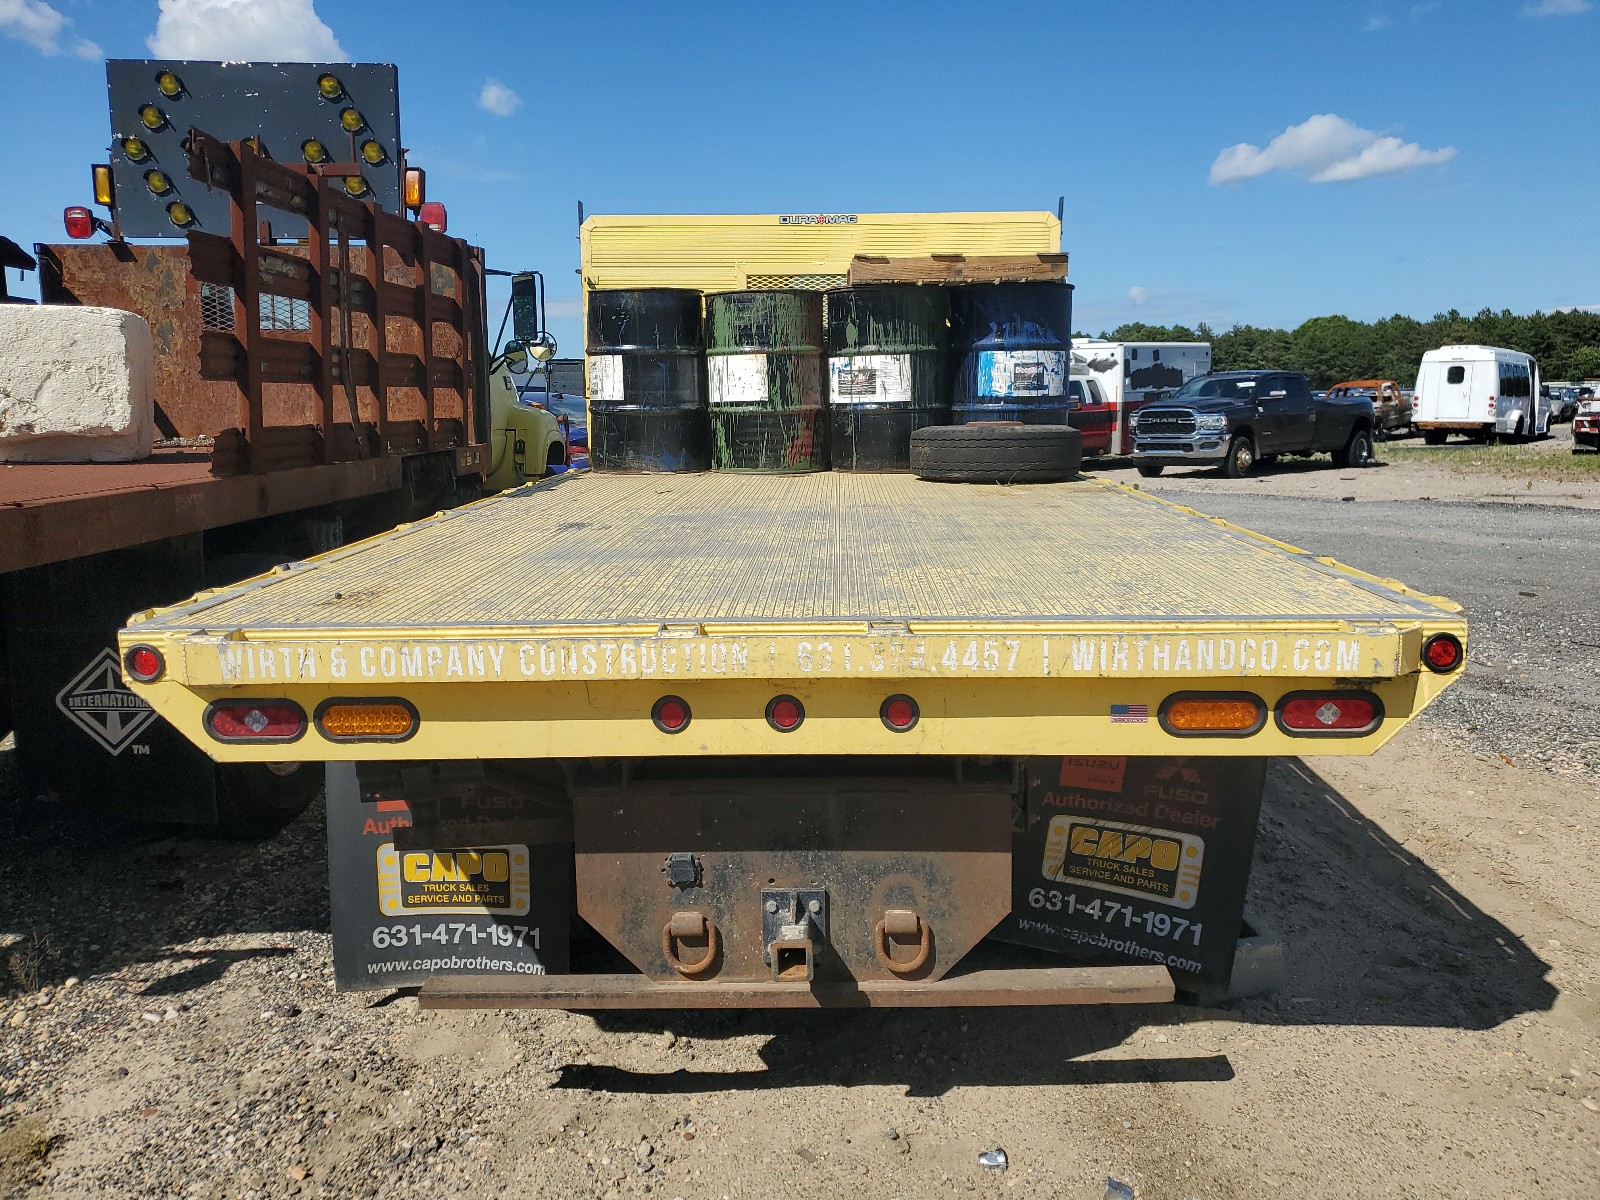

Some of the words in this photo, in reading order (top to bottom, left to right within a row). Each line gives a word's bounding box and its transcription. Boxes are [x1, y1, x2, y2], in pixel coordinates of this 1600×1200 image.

[219, 646, 316, 679] WIRTH
[330, 647, 347, 678] &
[359, 644, 505, 677] COMPANY
[519, 642, 748, 676] CONSTRUCTION
[1071, 638, 1360, 672] WIRTHANDCO.COM
[68, 693, 151, 708] INTERNATIONA
[132, 745, 150, 755] TM
[1042, 791, 1149, 819] Authorized
[1154, 803, 1221, 829] Dealer
[1069, 826, 1180, 872] CAPO
[403, 852, 509, 883] CAPO
[1069, 865, 1112, 880] SERVICE
[1112, 873, 1136, 885] AND
[1136, 878, 1170, 893] PARTS
[1086, 858, 1120, 871] TRUCK
[1122, 864, 1155, 878] SALES
[407, 895, 450, 904] SERVICE
[451, 895, 472, 903] AND
[474, 895, 505, 904] PARTS
[422, 883, 457, 892] TRUCK
[459, 883, 490, 892] SALES
[1028, 886, 1203, 946] 631-471-1971
[372, 923, 541, 950] 631-471-1971
[367, 955, 546, 976] www.capobrothers.com
